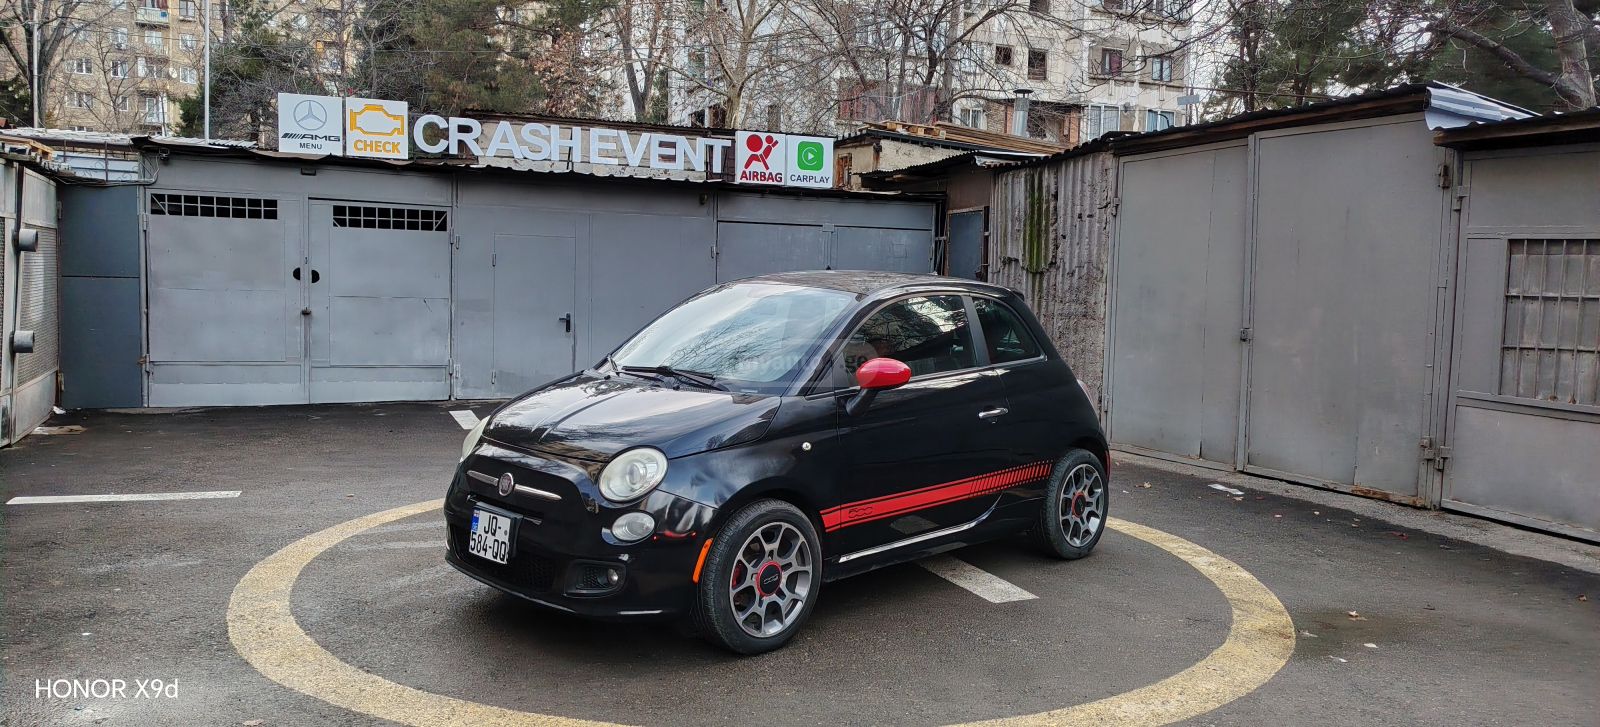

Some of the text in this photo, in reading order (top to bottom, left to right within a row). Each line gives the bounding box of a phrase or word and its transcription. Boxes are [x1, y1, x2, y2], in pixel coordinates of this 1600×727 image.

[299, 142, 323, 150] MENU
[353, 139, 401, 154] CHECK
[739, 170, 783, 183] AIRBAG
[790, 174, 830, 184] CARPLAY
[470, 531, 507, 562] 584-QQ
